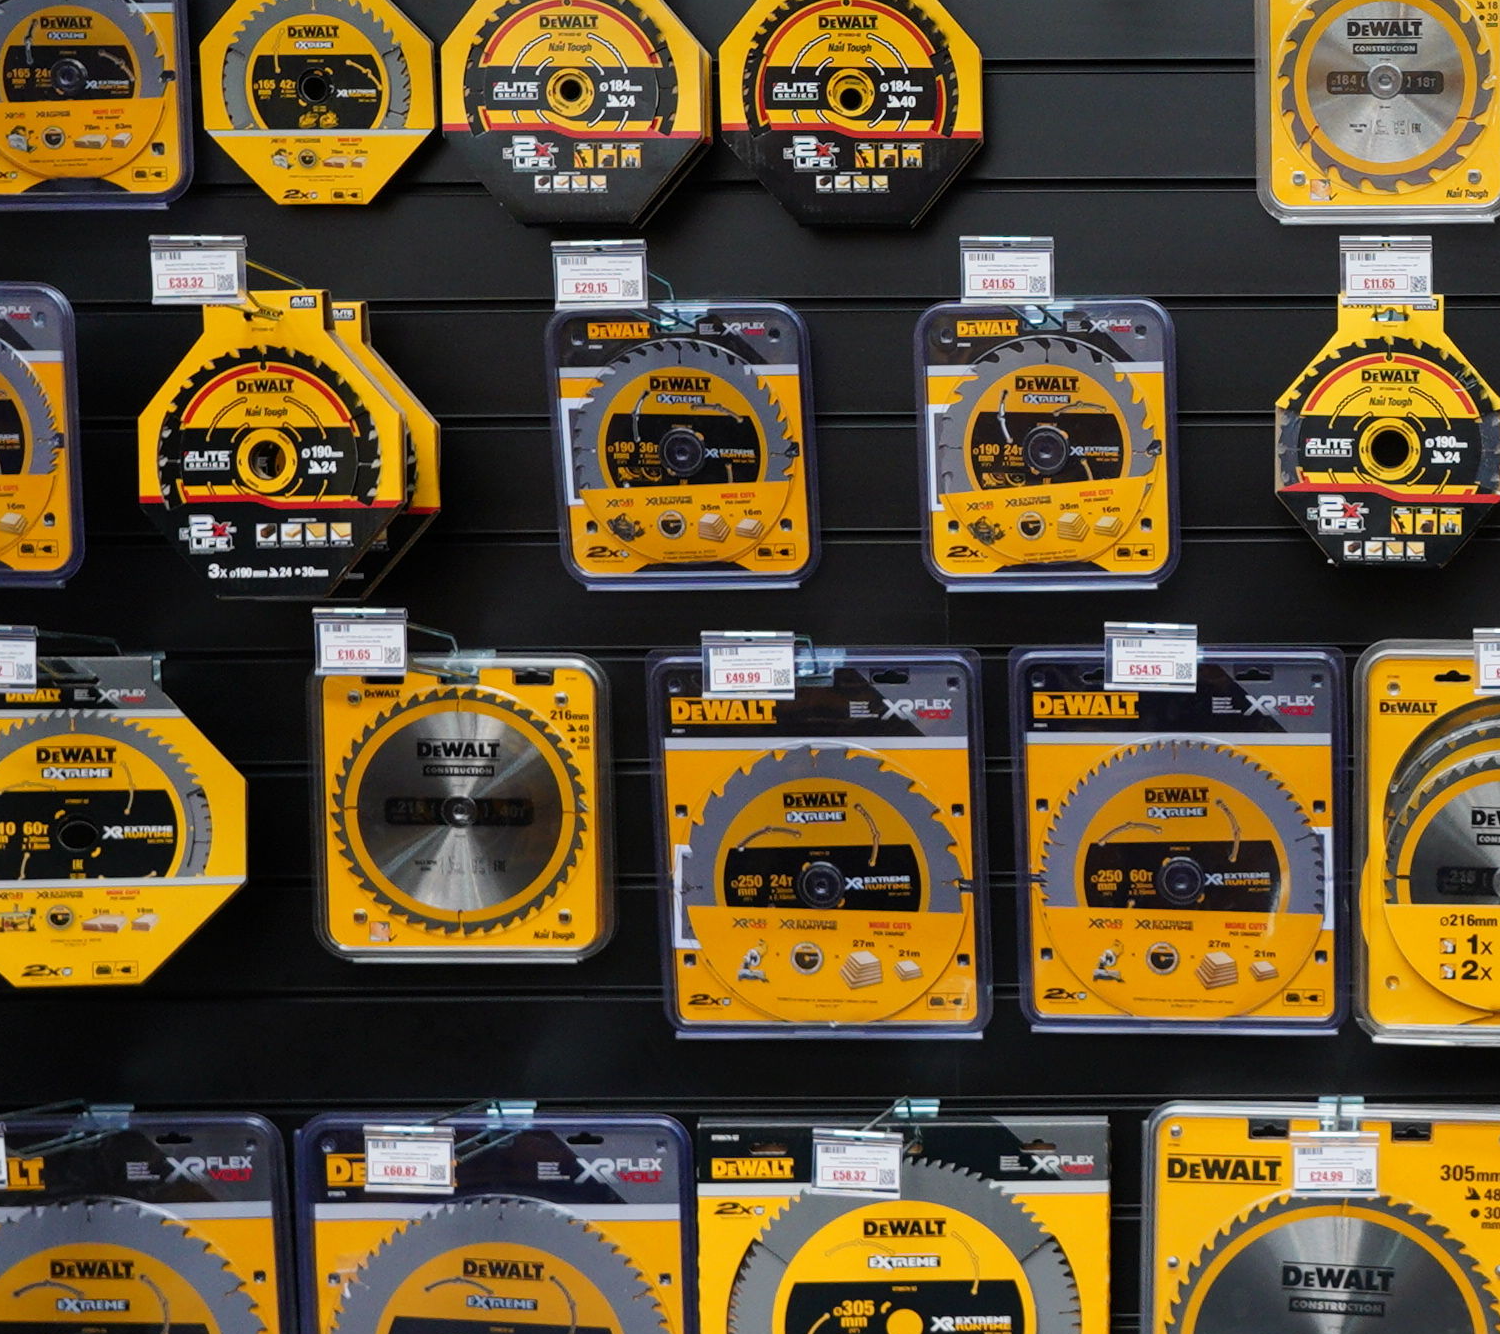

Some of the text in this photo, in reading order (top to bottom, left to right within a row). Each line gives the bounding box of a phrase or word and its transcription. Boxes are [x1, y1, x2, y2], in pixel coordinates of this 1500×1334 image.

[1347, 21, 1422, 36] DEWALT
[169, 277, 203, 289] £33.32
[574, 283, 608, 294] £29.15
[981, 279, 1015, 290] £41.65
[1363, 278, 1396, 289] £11.65
[237, 379, 294, 393] DEWALT
[1129, 665, 1162, 675] £54.15
[725, 673, 761, 683] £49.99
[914, 699, 951, 710] FLEX
[550, 708, 589, 720] 216mm
[672, 701, 776, 720] DEWALT
[712, 1158, 793, 1178] DEWALT
[1167, 1158, 1281, 1181] DEWALT
[1310, 1172, 1343, 1182] £24.99
